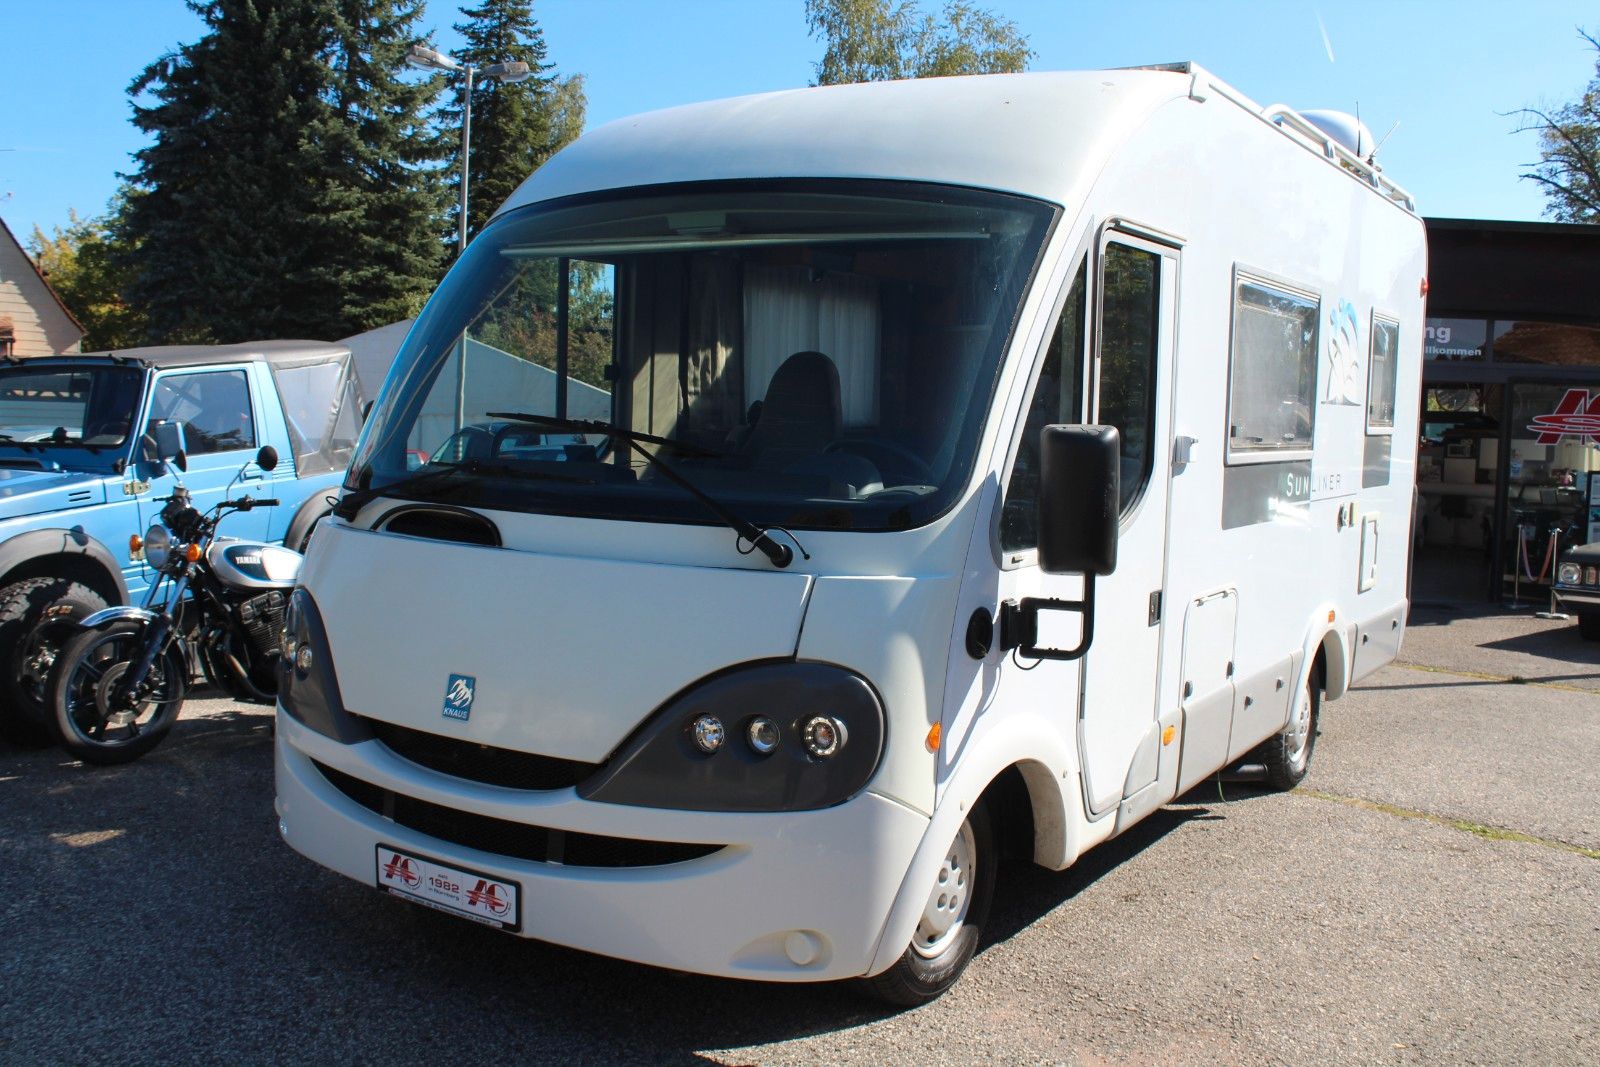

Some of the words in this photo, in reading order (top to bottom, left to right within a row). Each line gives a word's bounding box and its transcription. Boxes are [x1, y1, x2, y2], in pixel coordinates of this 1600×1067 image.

[235, 556, 261, 564] YAMAHA
[443, 707, 468, 718] KNAUS
[429, 877, 460, 894] 1982
